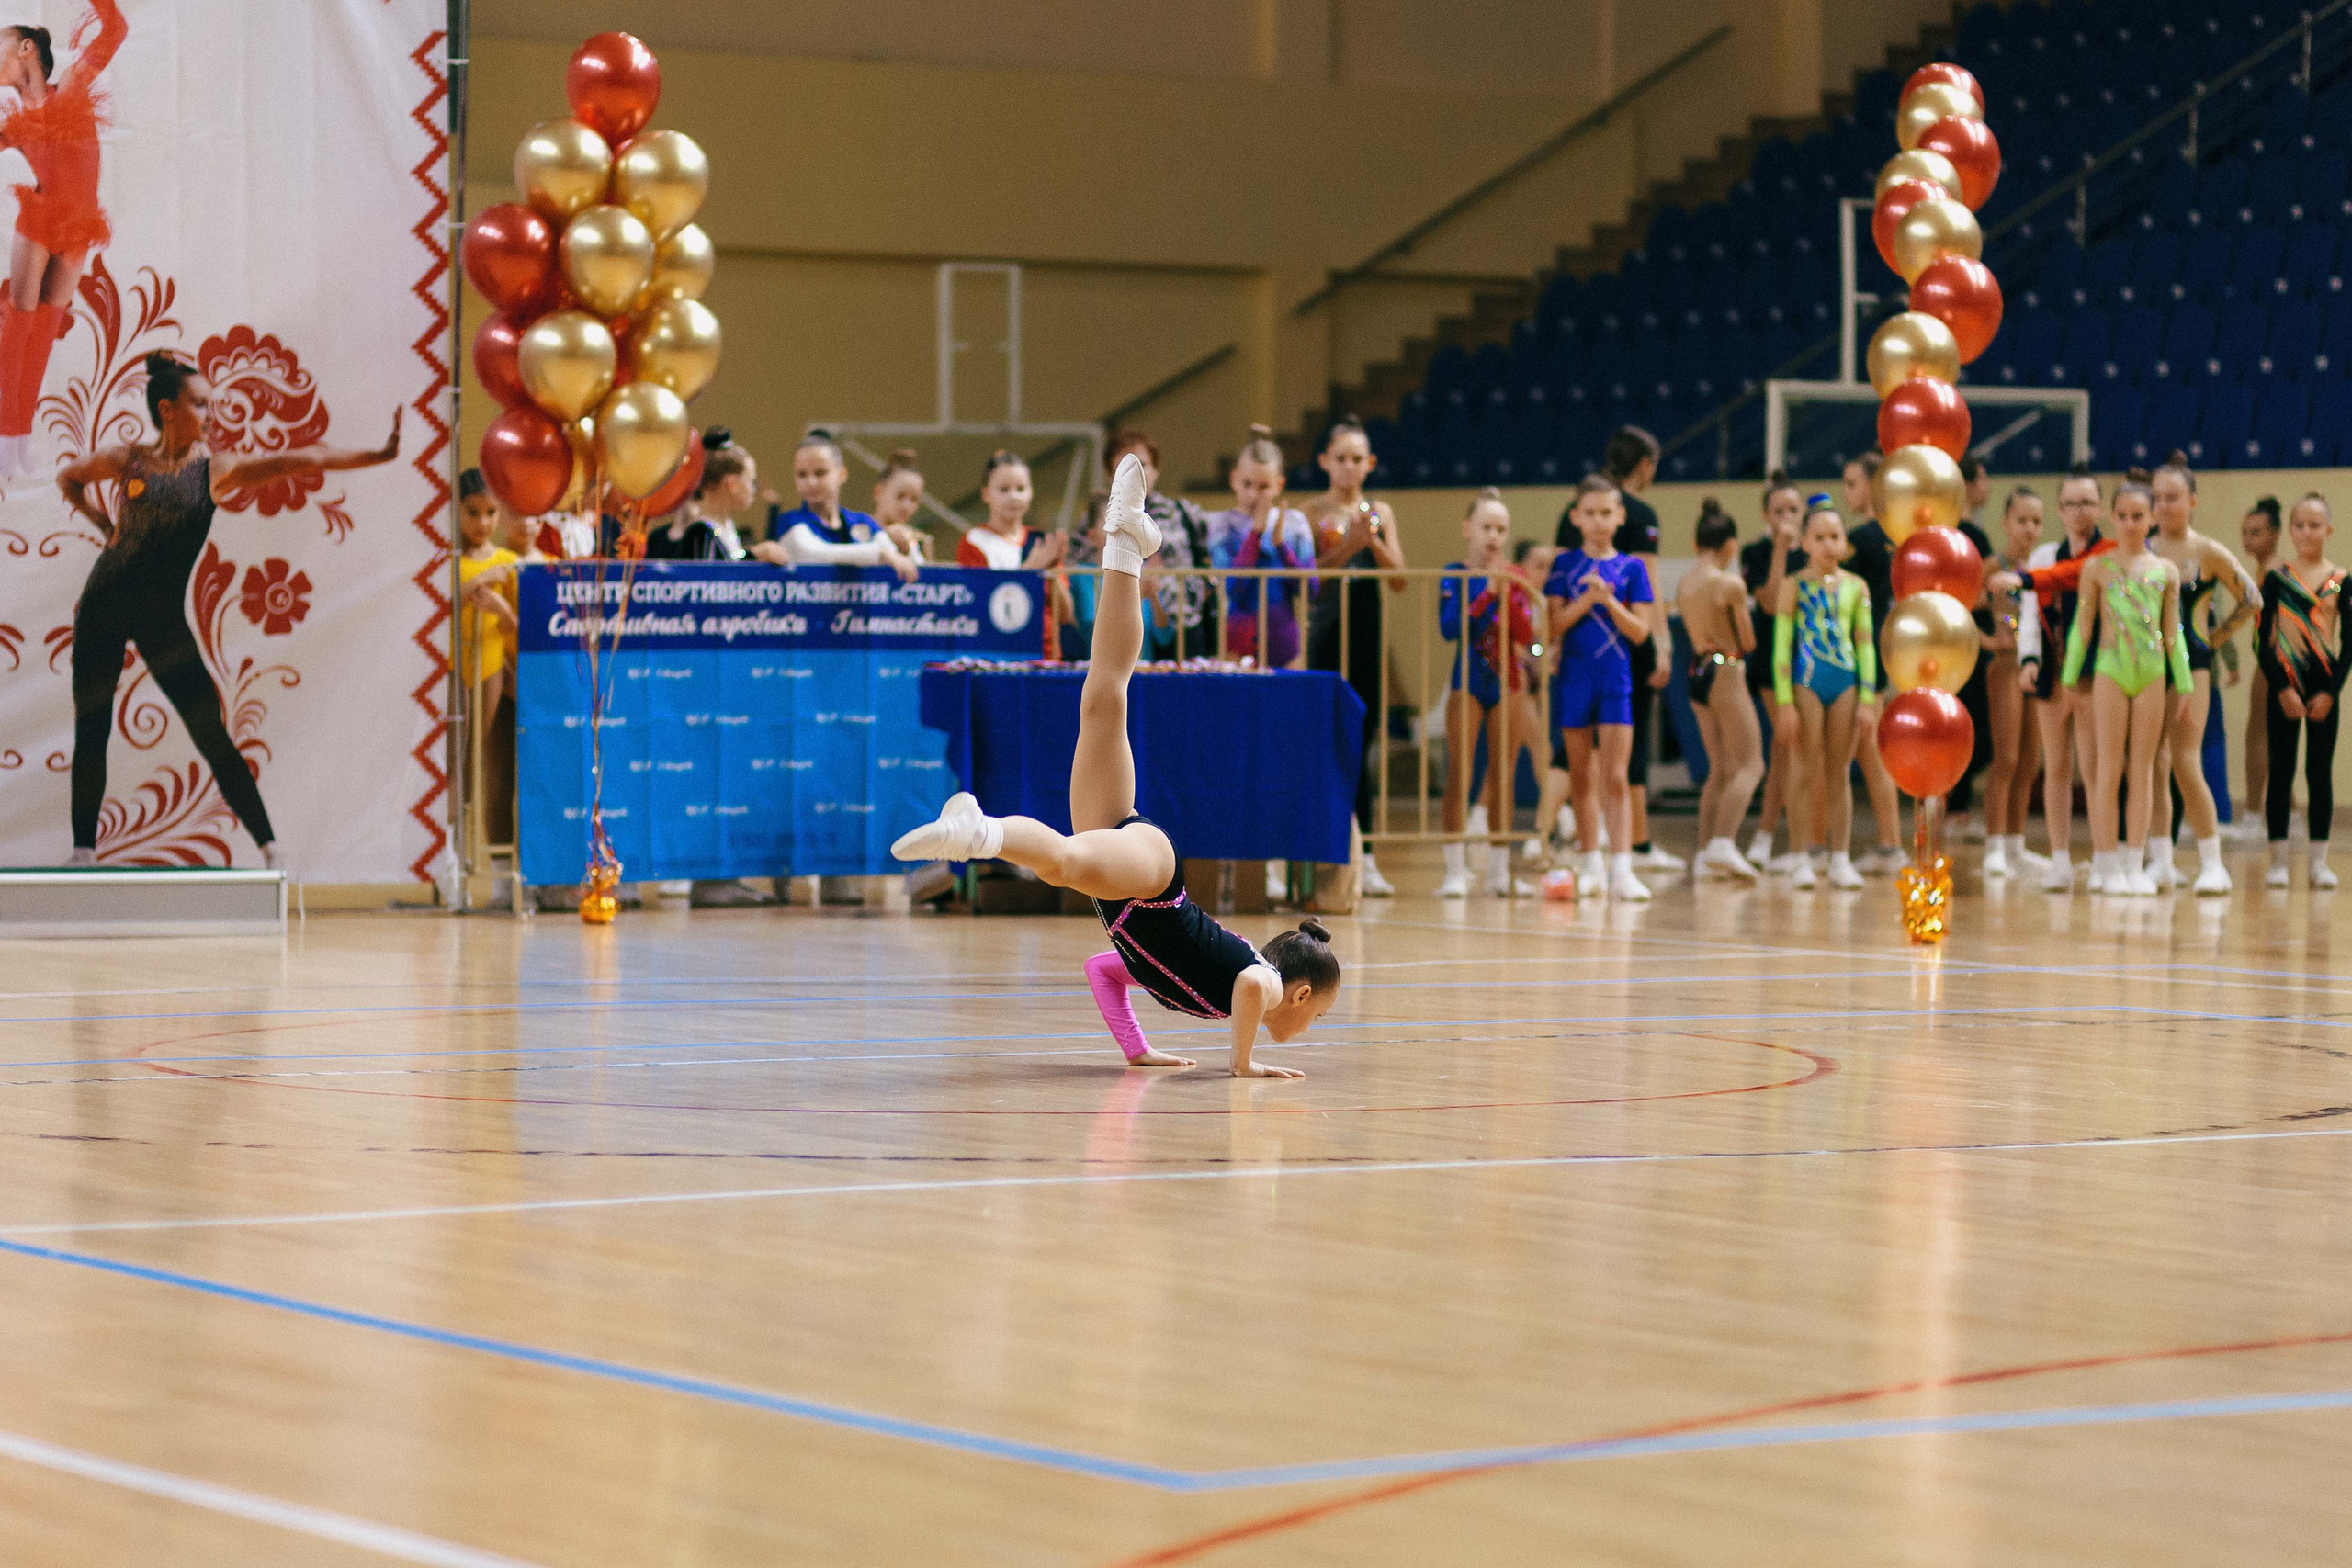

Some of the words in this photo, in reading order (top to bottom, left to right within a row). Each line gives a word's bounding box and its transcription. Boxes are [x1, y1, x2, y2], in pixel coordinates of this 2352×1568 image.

[631, 581, 784, 604] СПОРТИВНОГО
[786, 581, 889, 604] РАЗВИТИЯ
[701, 610, 807, 642] аэробика
[831, 609, 979, 636] Гимнастика
